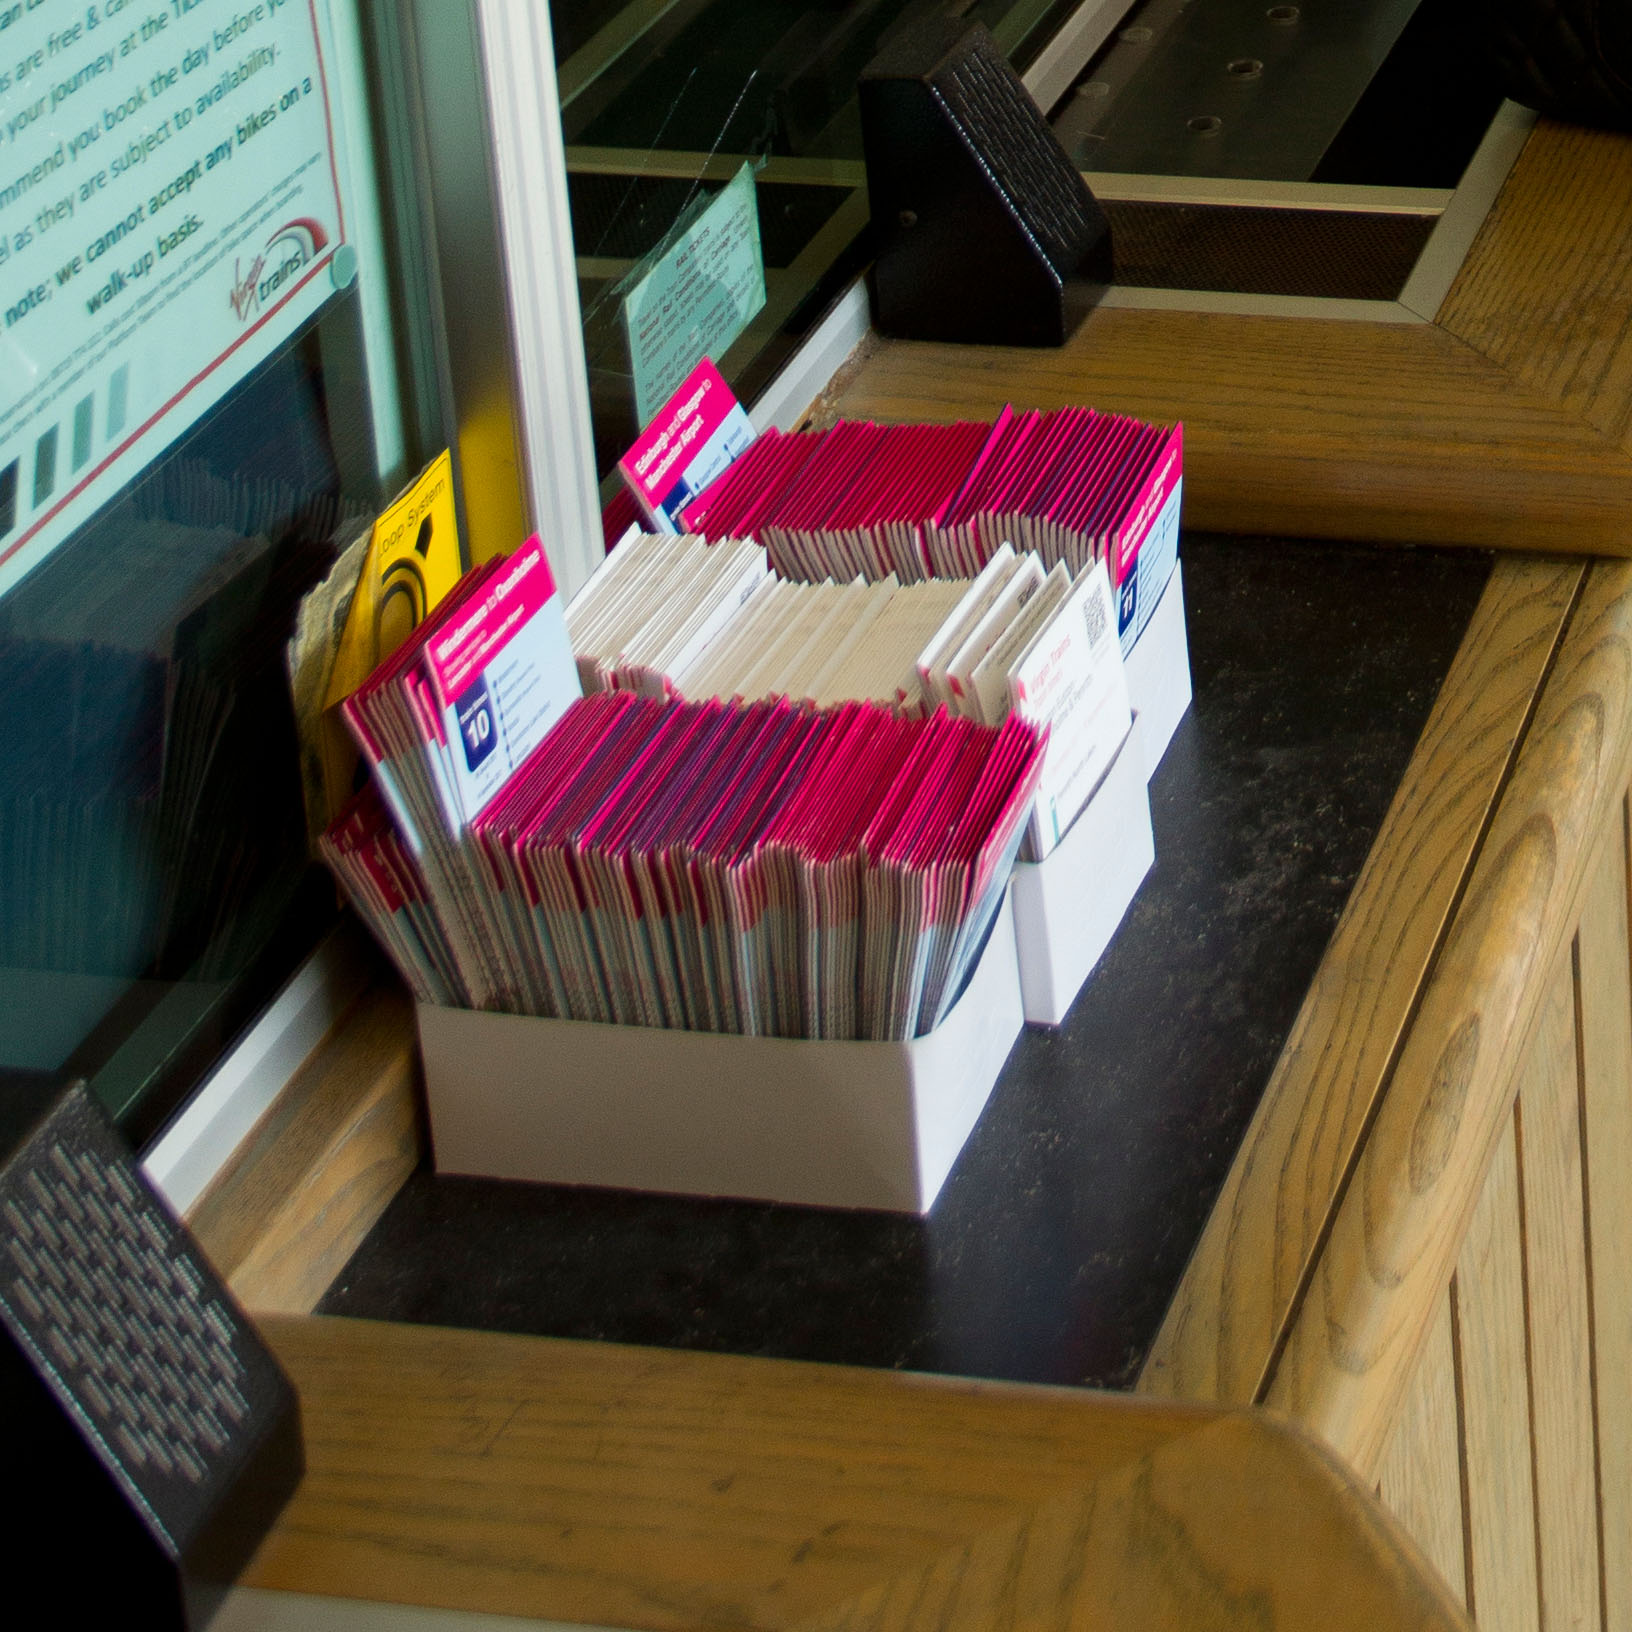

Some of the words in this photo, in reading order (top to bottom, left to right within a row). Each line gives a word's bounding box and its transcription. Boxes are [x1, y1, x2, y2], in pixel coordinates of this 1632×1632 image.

[5, 94, 48, 145] your
[48, 48, 117, 114] journey
[119, 32, 139, 59] at
[140, 11, 169, 42] the
[16, 48, 46, 83] are
[47, 21, 83, 59] free
[86, 5, 101, 32] &
[66, 122, 102, 164] you
[102, 86, 149, 132] book
[150, 63, 179, 98] the
[181, 40, 211, 77] day
[213, 2, 266, 53] before
[13, 224, 34, 252] as
[35, 191, 75, 235] they
[79, 169, 108, 204] are
[109, 119, 173, 180] subject
[173, 105, 194, 133] to
[195, 42, 282, 117] availability.
[54, 254, 82, 288] we
[85, 204, 146, 265] cannot
[148, 159, 205, 217] accept
[205, 136, 235, 172] any
[235, 108, 279, 147] bikes
[279, 86, 301, 113] on
[302, 76, 313, 96] a
[86, 249, 156, 315] walk-up
[156, 212, 205, 259] basis.
[259, 249, 302, 303] trains
[634, 431, 671, 477] Edinburgh
[667, 415, 682, 438] and
[676, 386, 706, 423] Glasgow
[701, 378, 712, 392] to
[644, 439, 684, 491] Manchester
[680, 413, 704, 447] Airport
[407, 477, 446, 530] System
[436, 603, 489, 662] Windermere
[494, 549, 541, 601] Oxenholme
[1122, 588, 1134, 620] 11
[467, 708, 490, 748] 10
